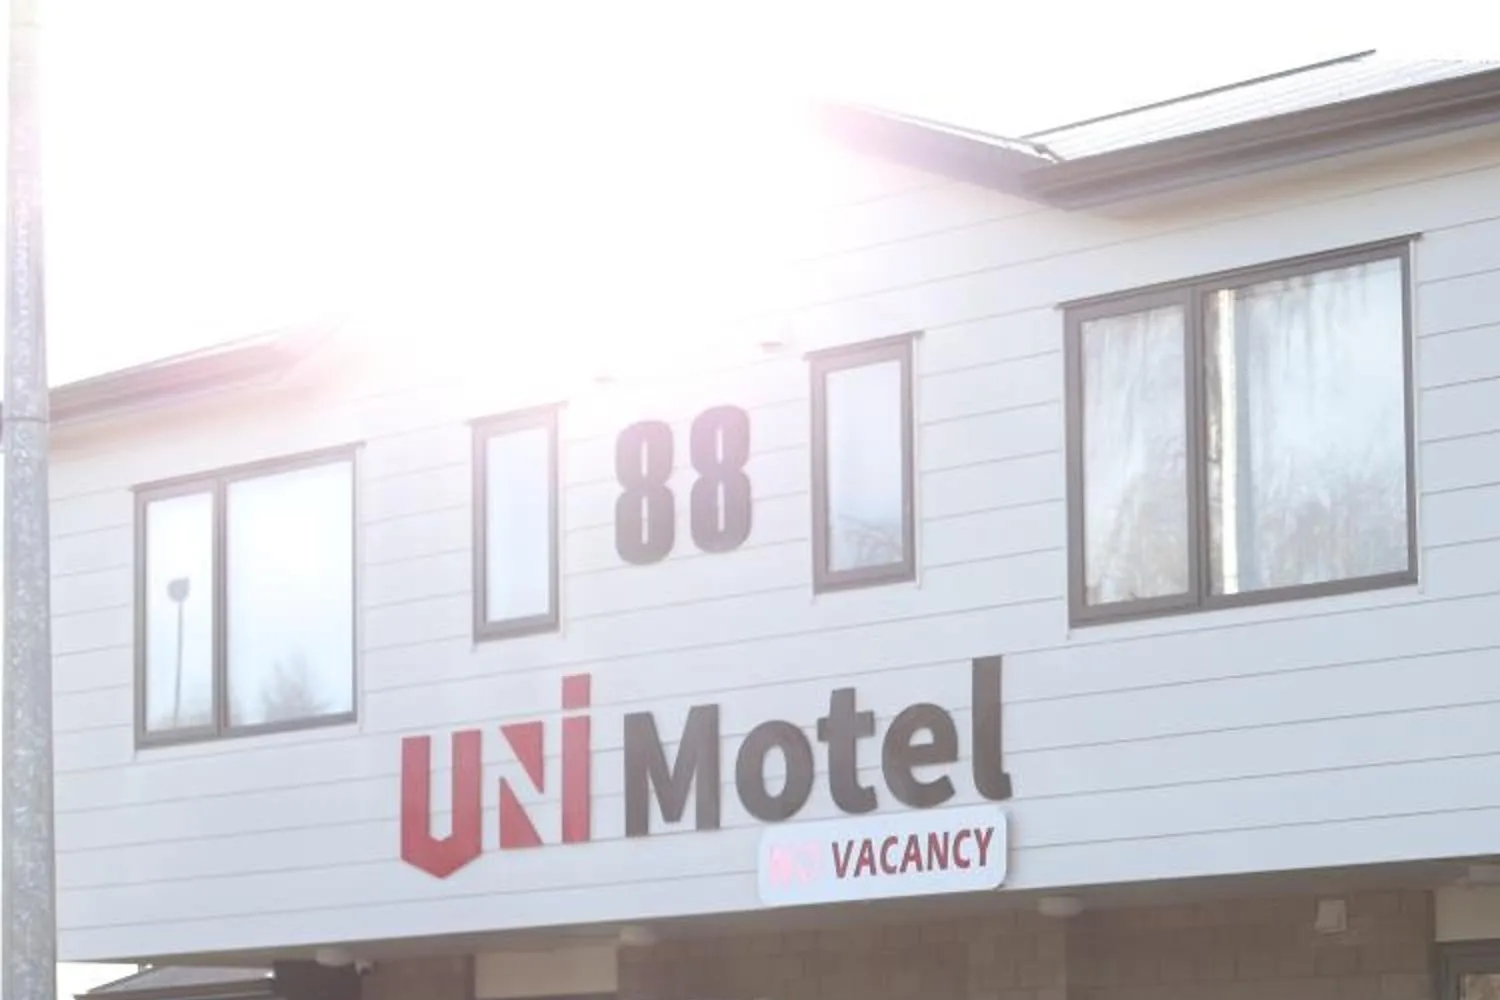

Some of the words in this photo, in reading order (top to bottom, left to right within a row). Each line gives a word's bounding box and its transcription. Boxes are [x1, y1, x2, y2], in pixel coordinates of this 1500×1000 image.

[614, 404, 752, 565] 88
[623, 653, 1013, 838] Motel
[831, 826, 995, 879] VACANCY
